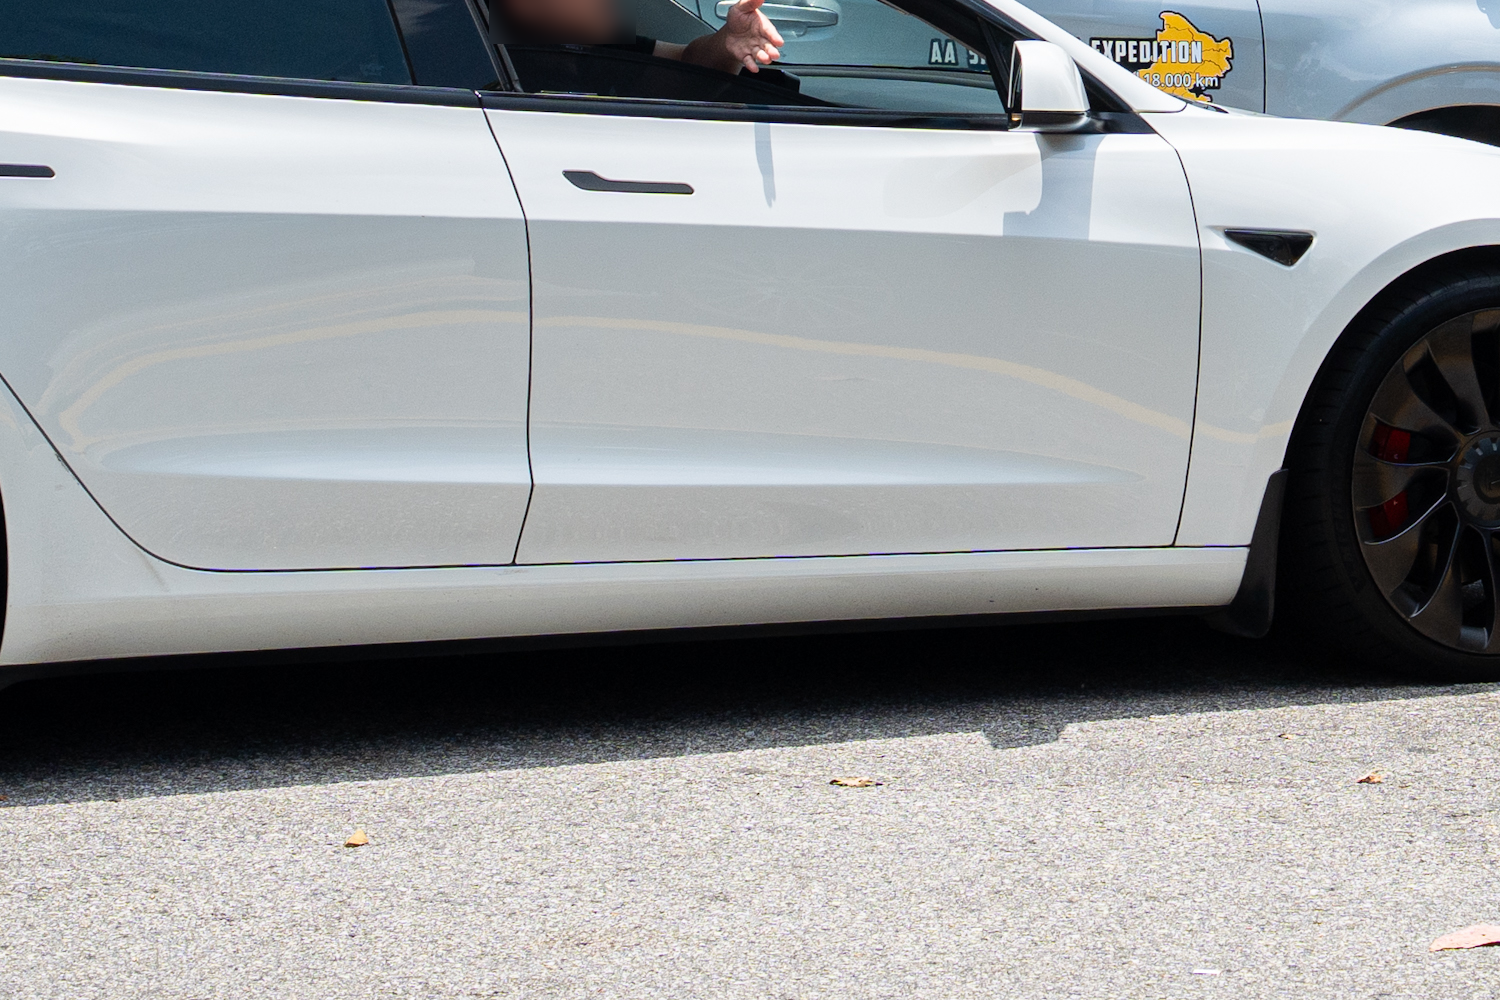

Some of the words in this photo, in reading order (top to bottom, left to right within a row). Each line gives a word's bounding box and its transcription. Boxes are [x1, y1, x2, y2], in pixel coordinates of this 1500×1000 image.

[930, 41, 956, 64] AA
[1091, 40, 1202, 63] EXPEDITION
[1143, 73, 1191, 87] 18.000
[1195, 73, 1219, 87] km
